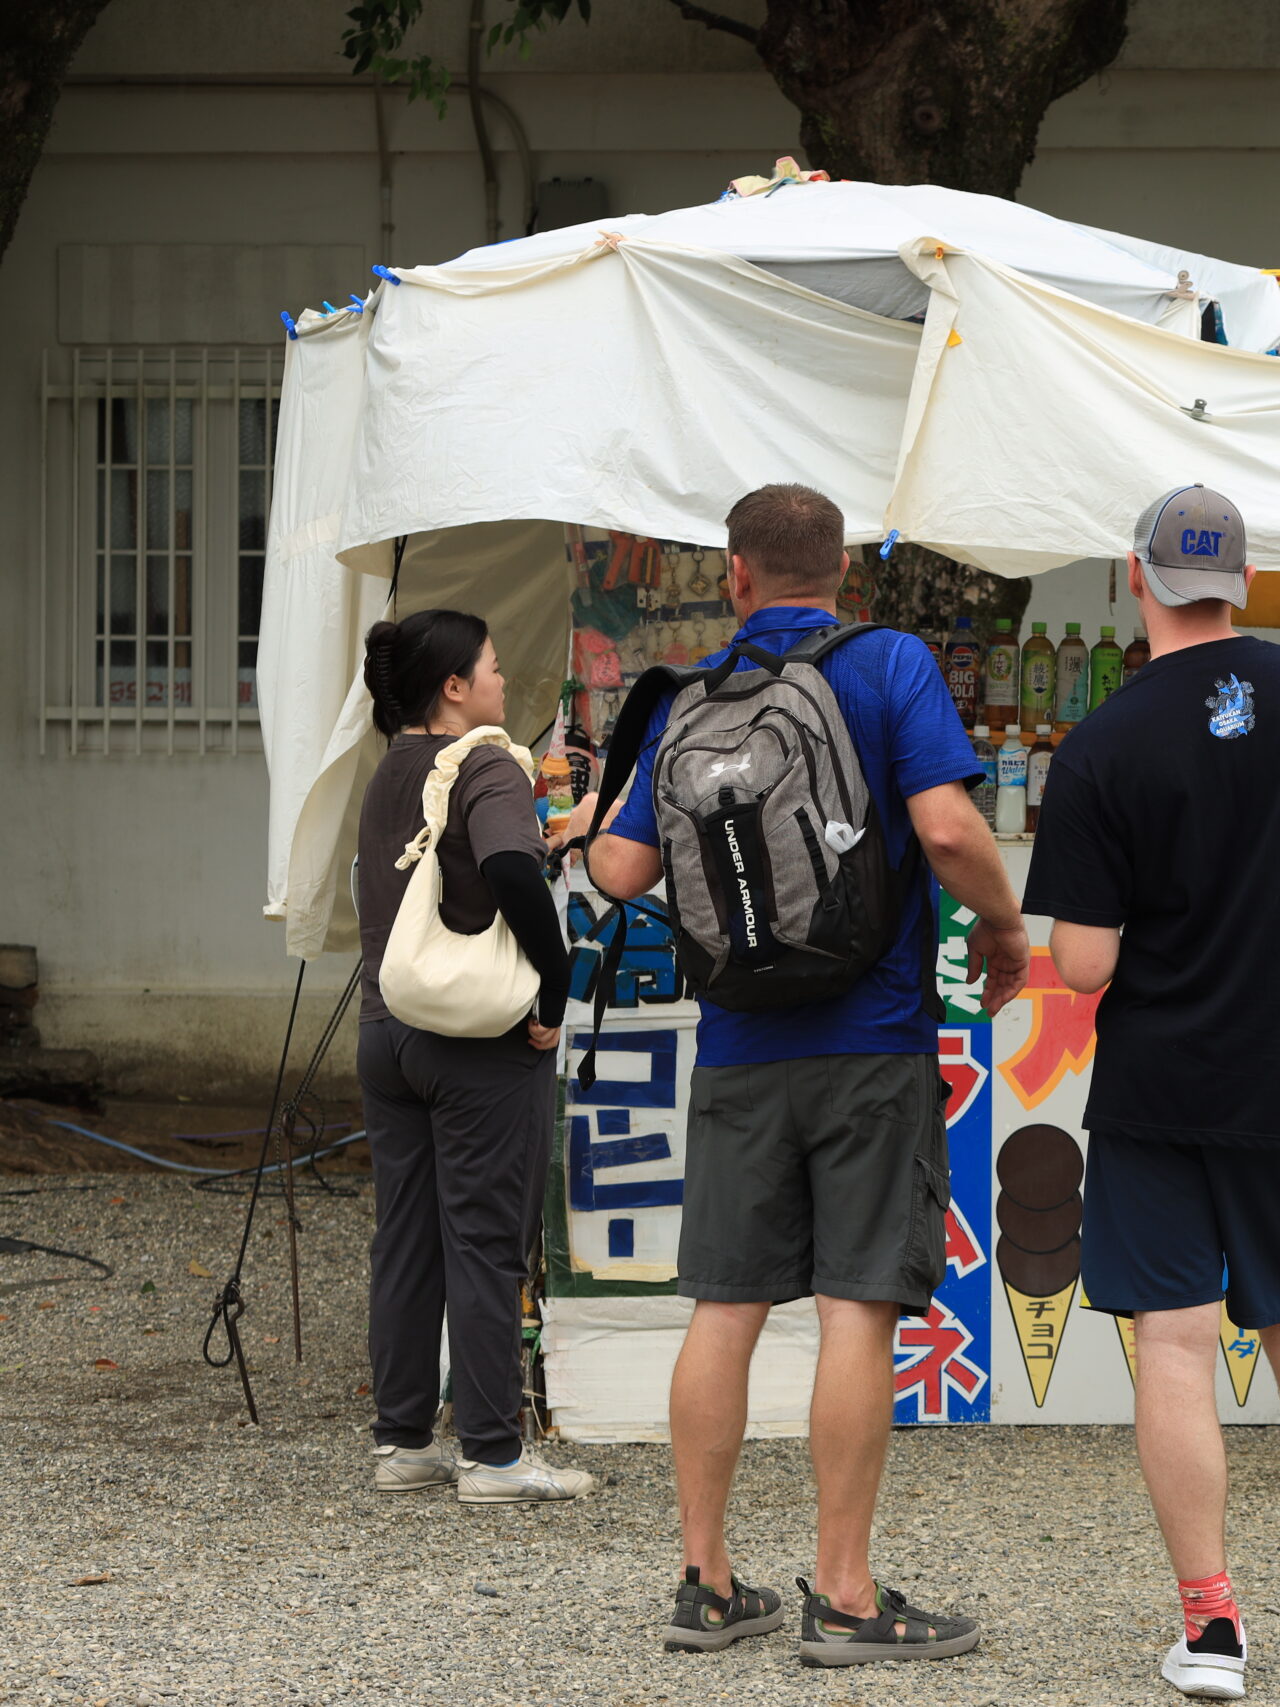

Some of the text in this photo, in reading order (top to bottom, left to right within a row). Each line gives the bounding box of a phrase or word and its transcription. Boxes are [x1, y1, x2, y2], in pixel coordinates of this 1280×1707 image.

[1181, 528, 1222, 557] CAT
[949, 671, 974, 683] BIG
[949, 684, 975, 697] COLA
[1212, 710, 1242, 722] KAIYUKAN
[1219, 717, 1238, 727] OSAKA
[1216, 721, 1244, 735] AQUARIUM
[1001, 766, 1025, 775] Water
[724, 820, 758, 948] UNDER ARMOUR
[1023, 1301, 1055, 1360] チョコ
